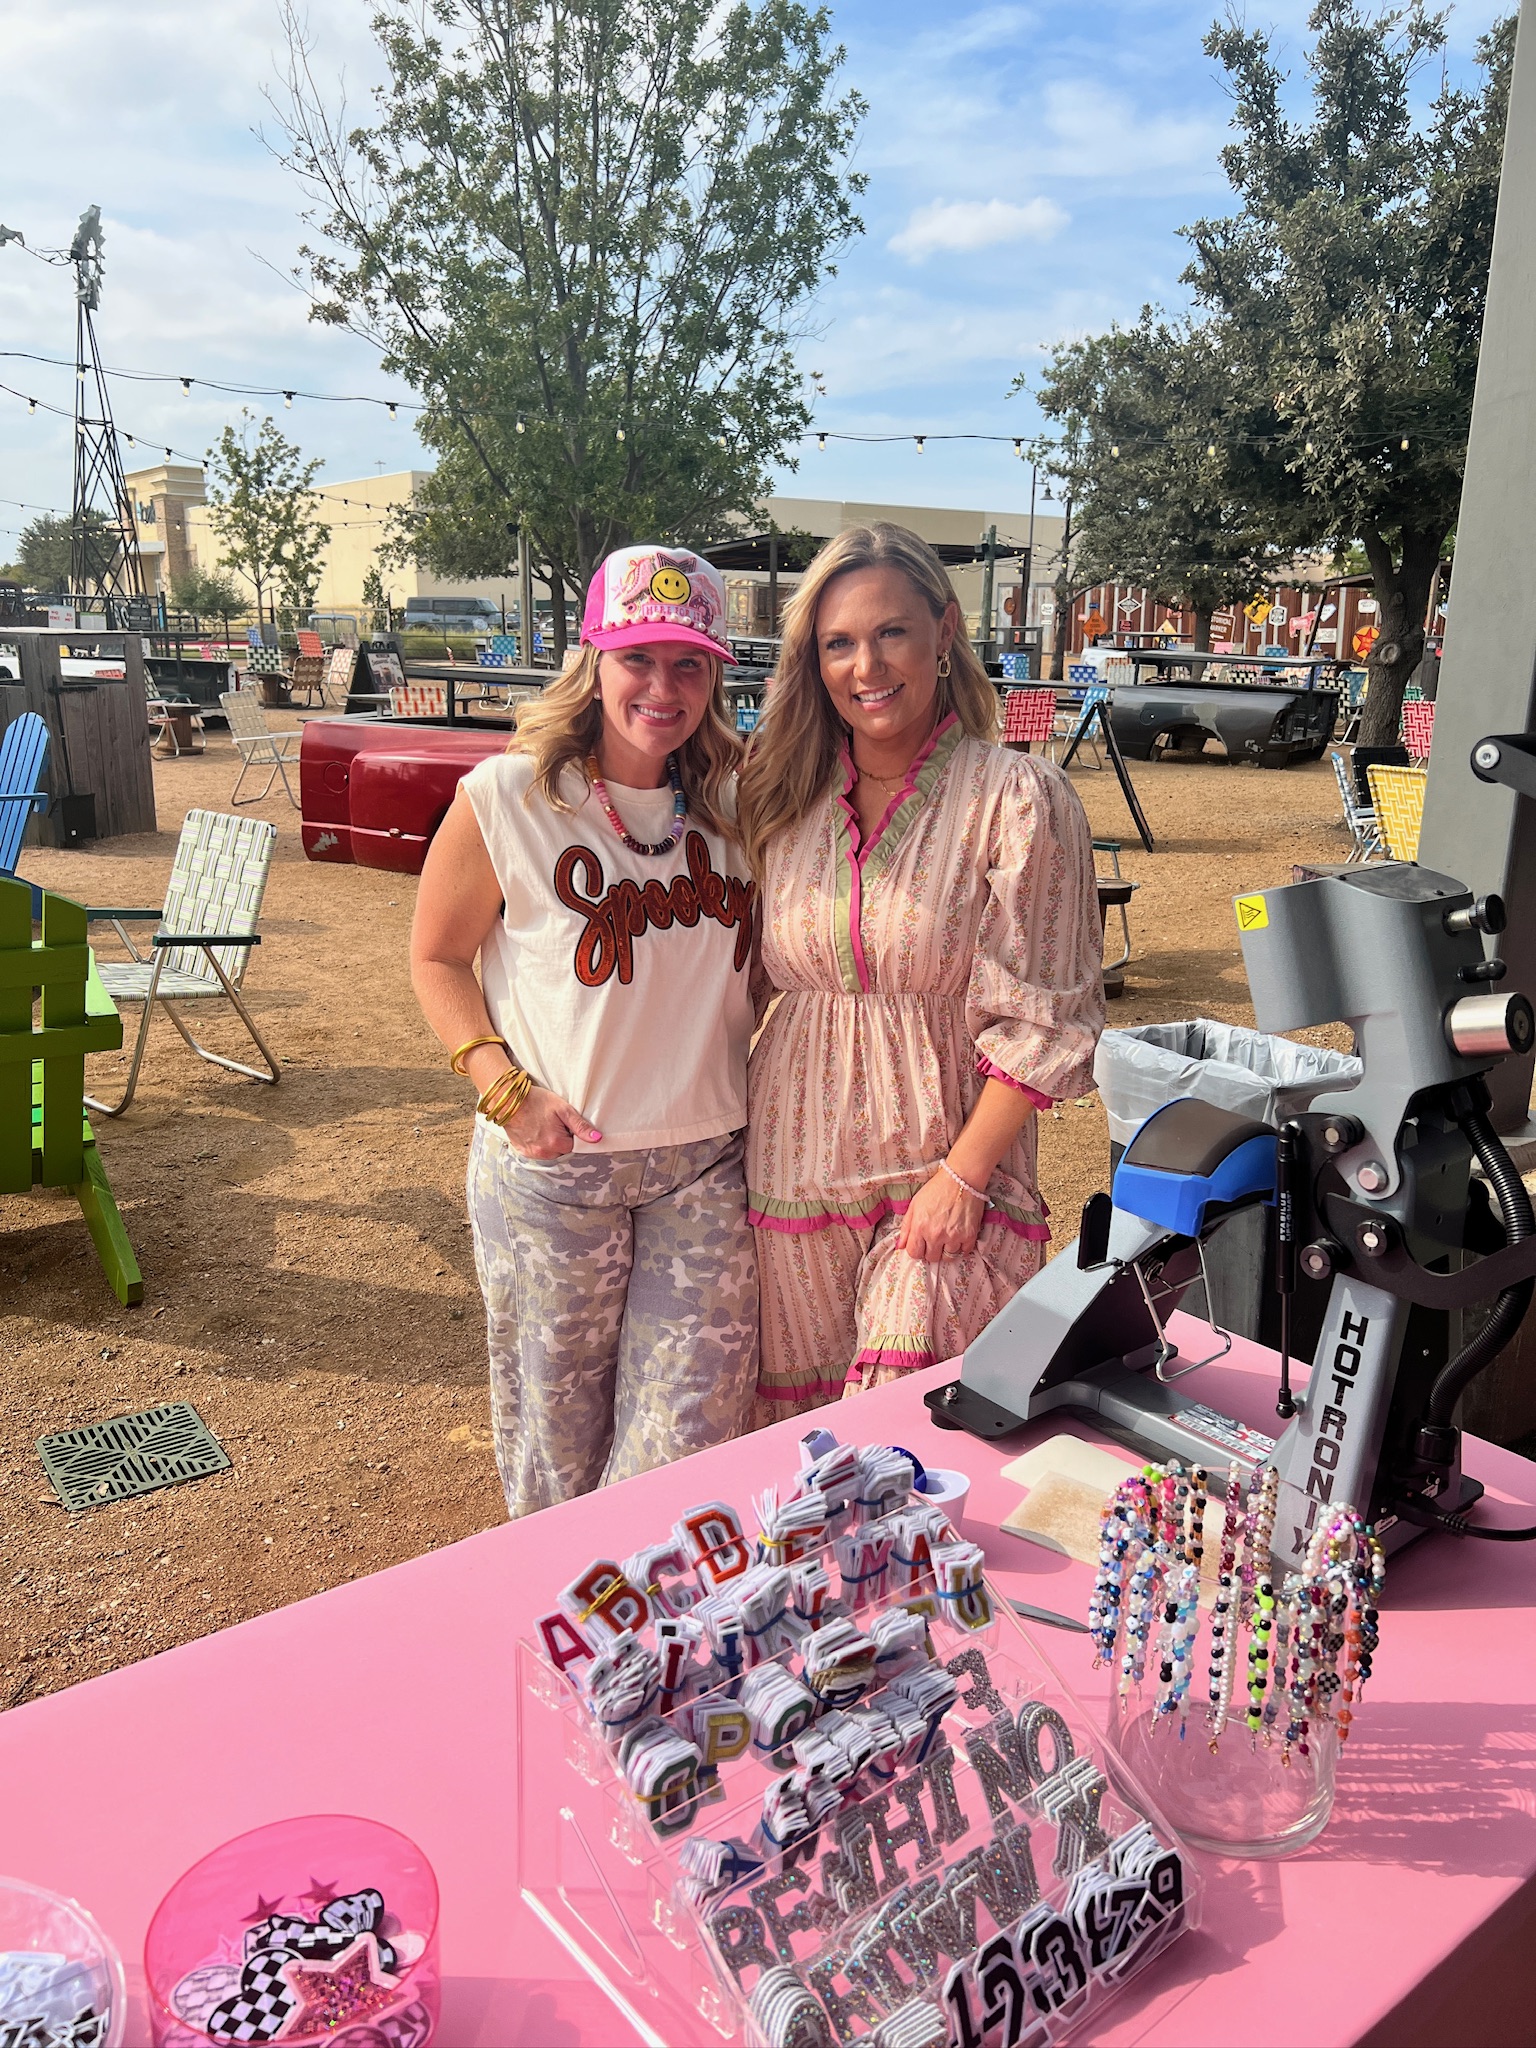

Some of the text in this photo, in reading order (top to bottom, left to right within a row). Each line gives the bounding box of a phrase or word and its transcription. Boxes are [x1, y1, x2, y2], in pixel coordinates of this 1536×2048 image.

[646, 605, 702, 623] HERE FOR IT
[554, 830, 757, 987] Spooky
[1279, 1191, 1287, 1242] STABILUS
